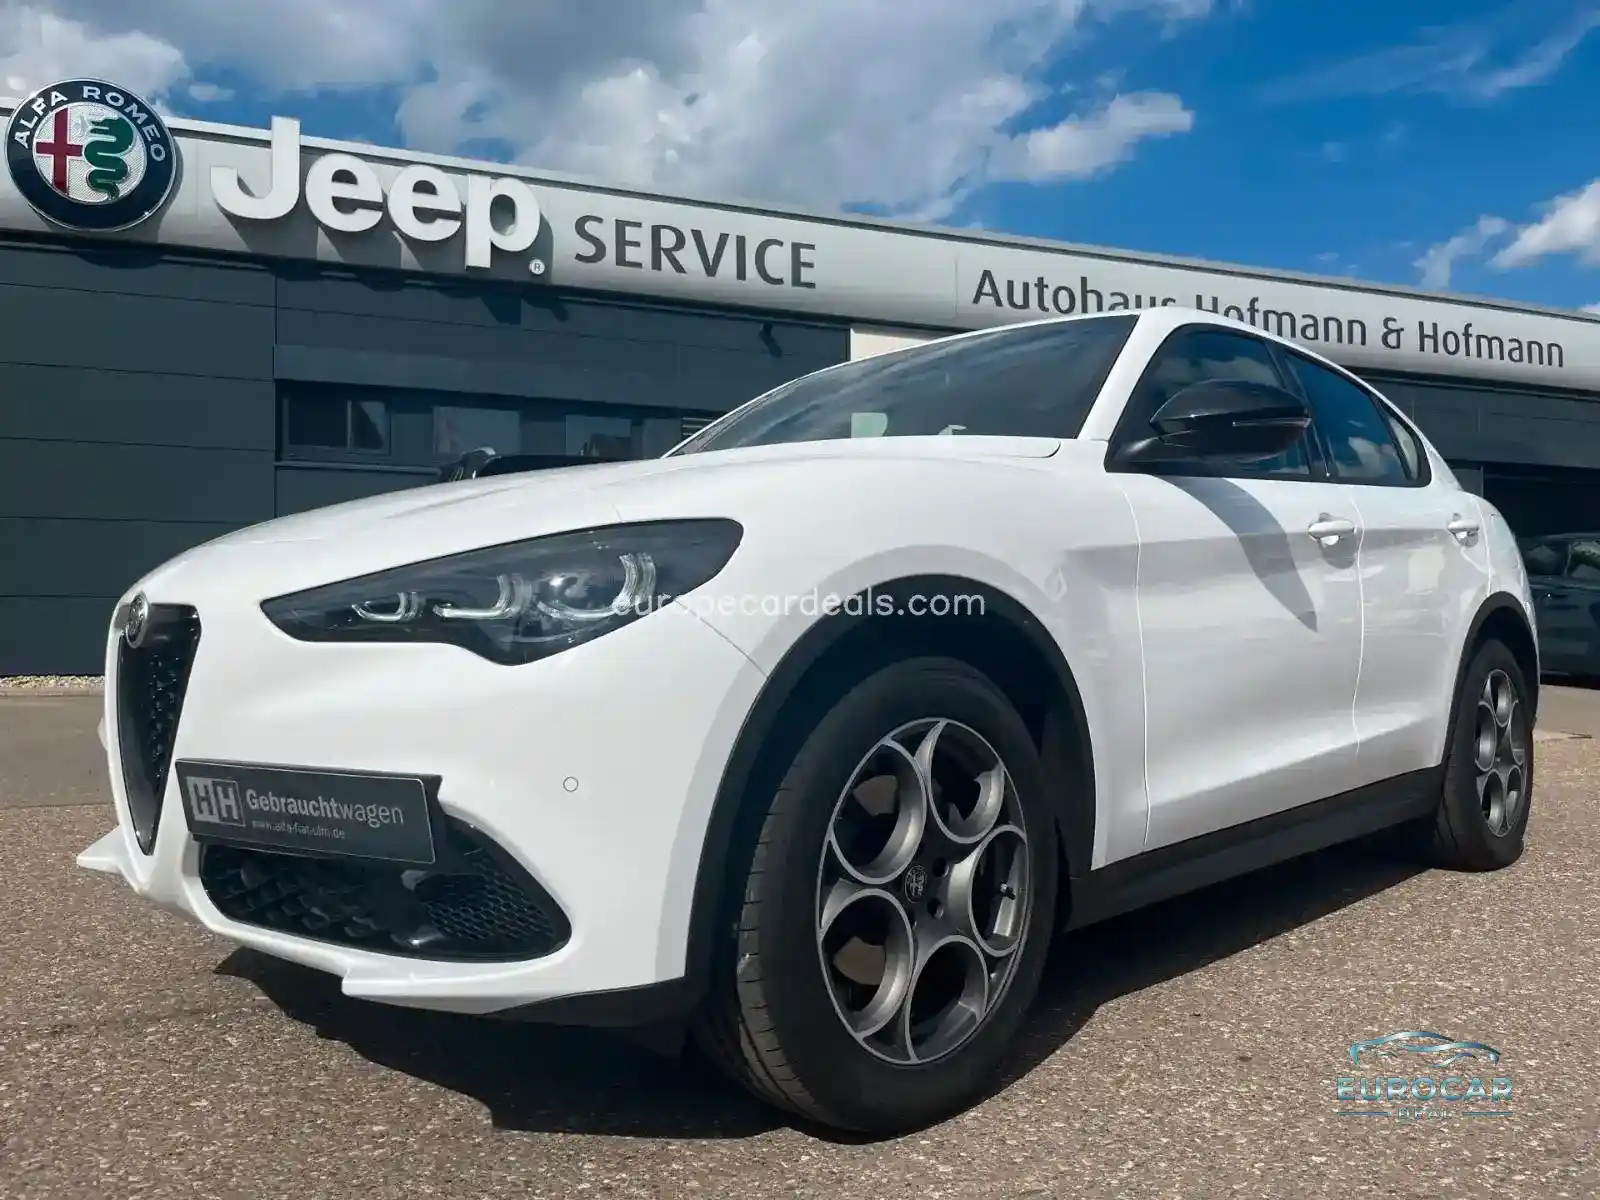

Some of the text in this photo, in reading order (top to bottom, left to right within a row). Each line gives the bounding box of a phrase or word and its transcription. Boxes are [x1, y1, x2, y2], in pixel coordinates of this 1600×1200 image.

[14, 85, 166, 162] ALFA ROMEO
[209, 115, 541, 269] Jeep
[574, 214, 817, 289] SERVICE
[1380, 318, 1404, 350] &
[1418, 320, 1564, 368] Hofmann
[246, 788, 405, 828] Gebrauchtwagen
